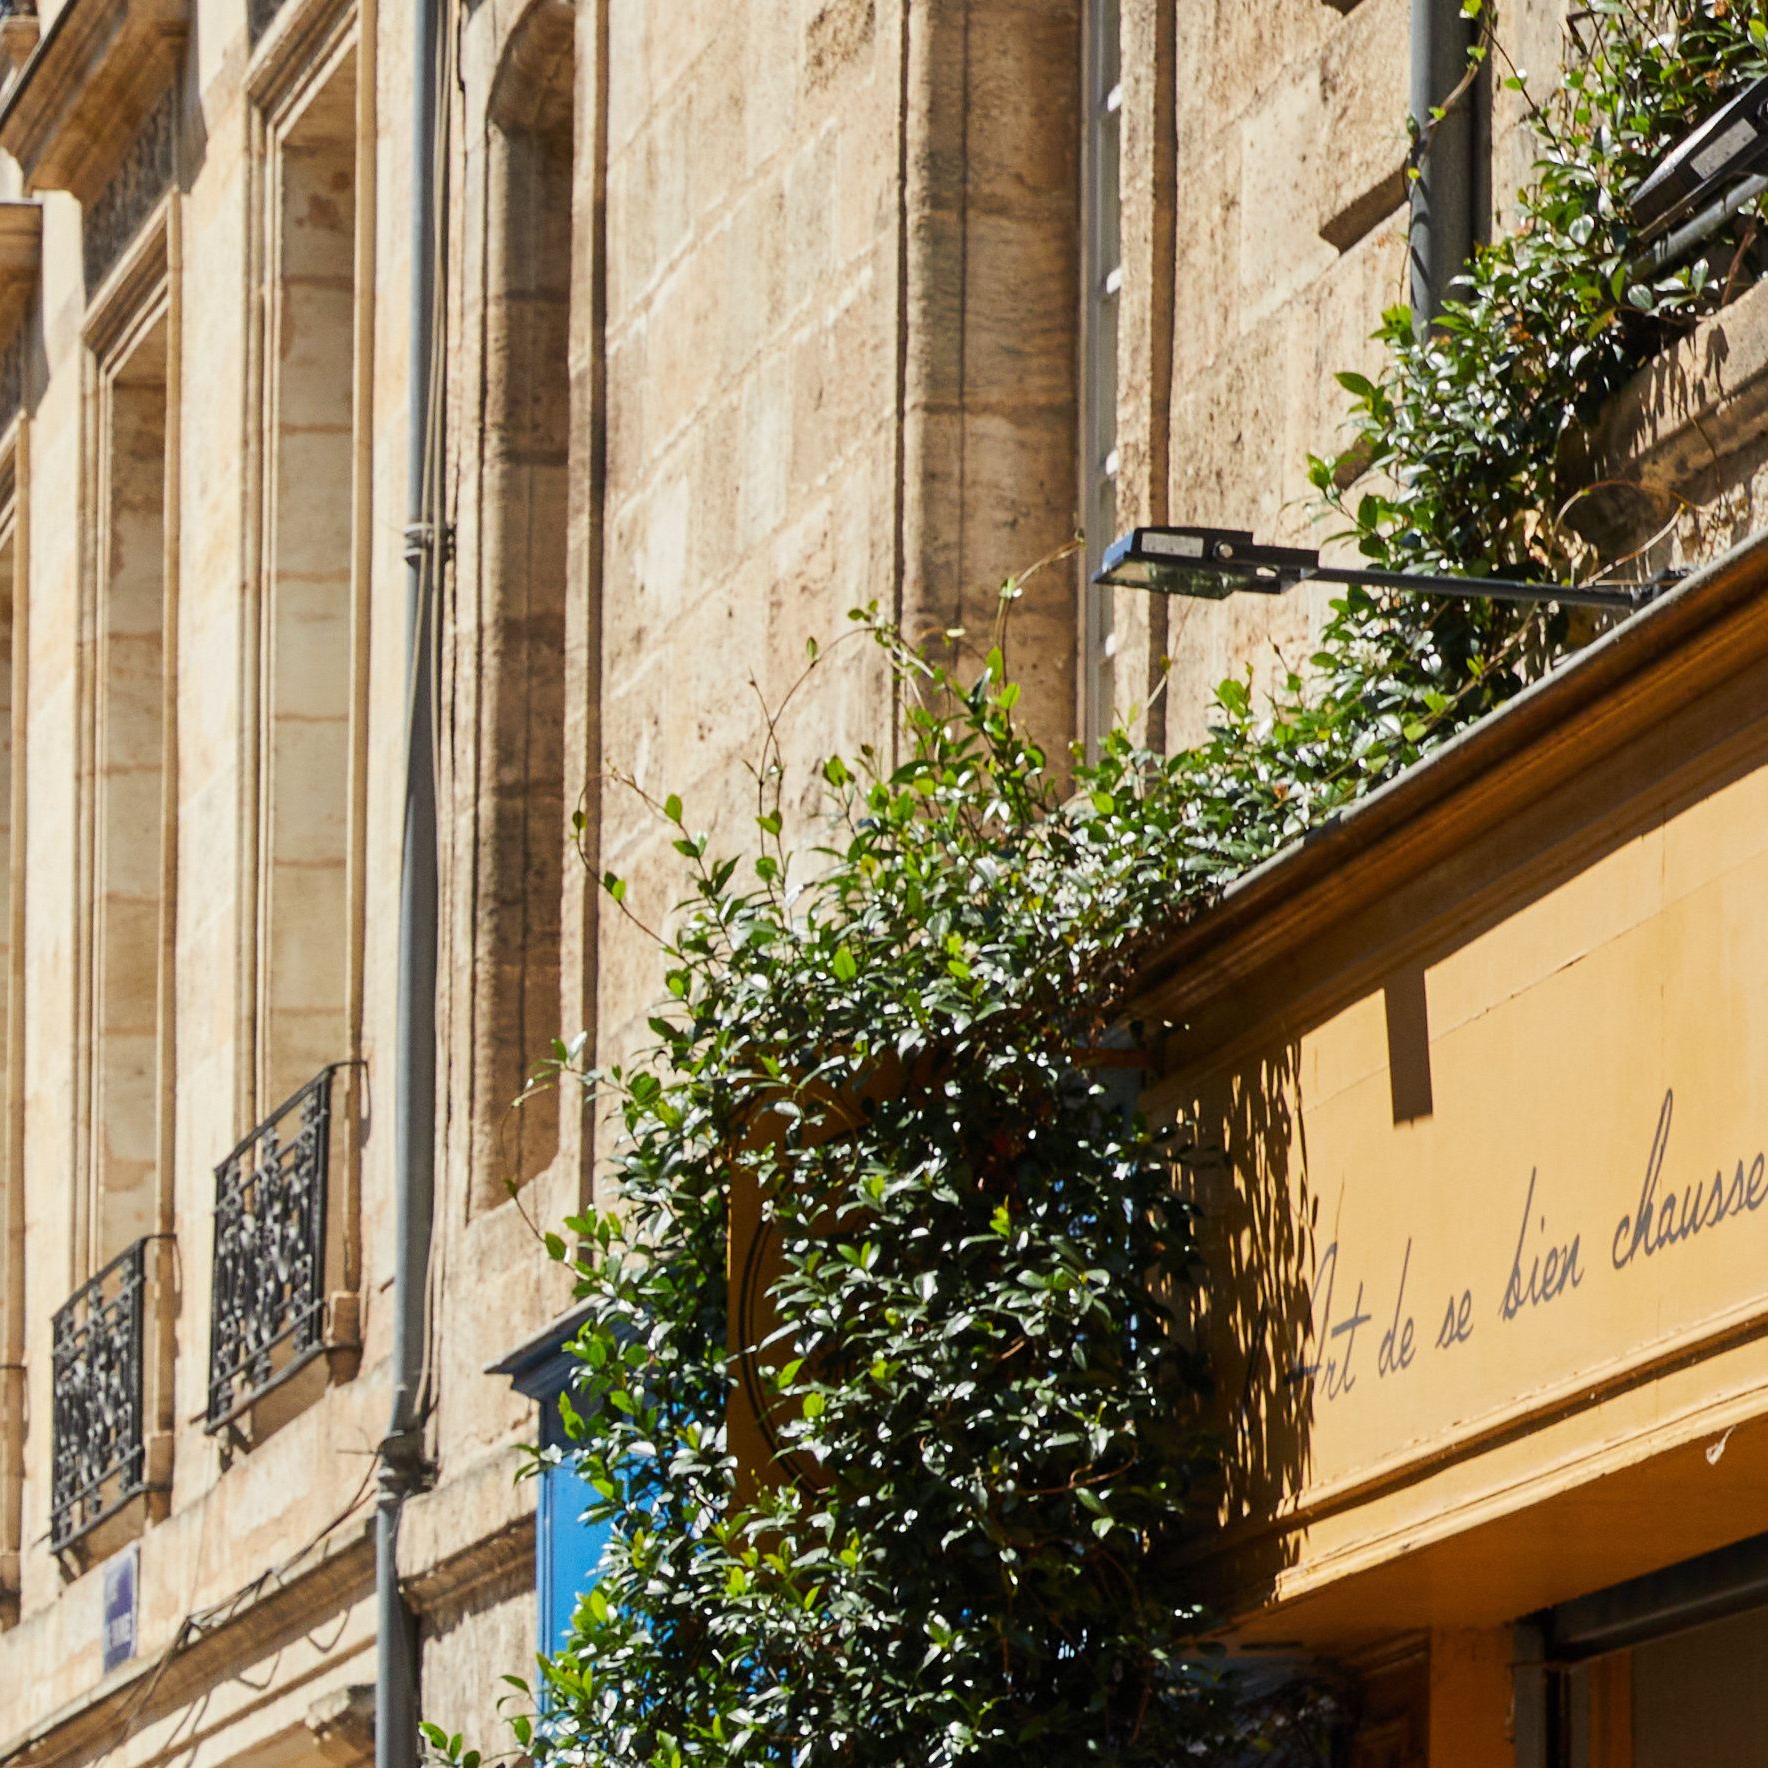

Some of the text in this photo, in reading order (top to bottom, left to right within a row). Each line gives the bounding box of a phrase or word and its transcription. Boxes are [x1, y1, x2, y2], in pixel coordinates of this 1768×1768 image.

[1378, 1237, 1416, 1379] de
[1435, 1288, 1474, 1349] se
[1499, 1166, 1584, 1322] bien
